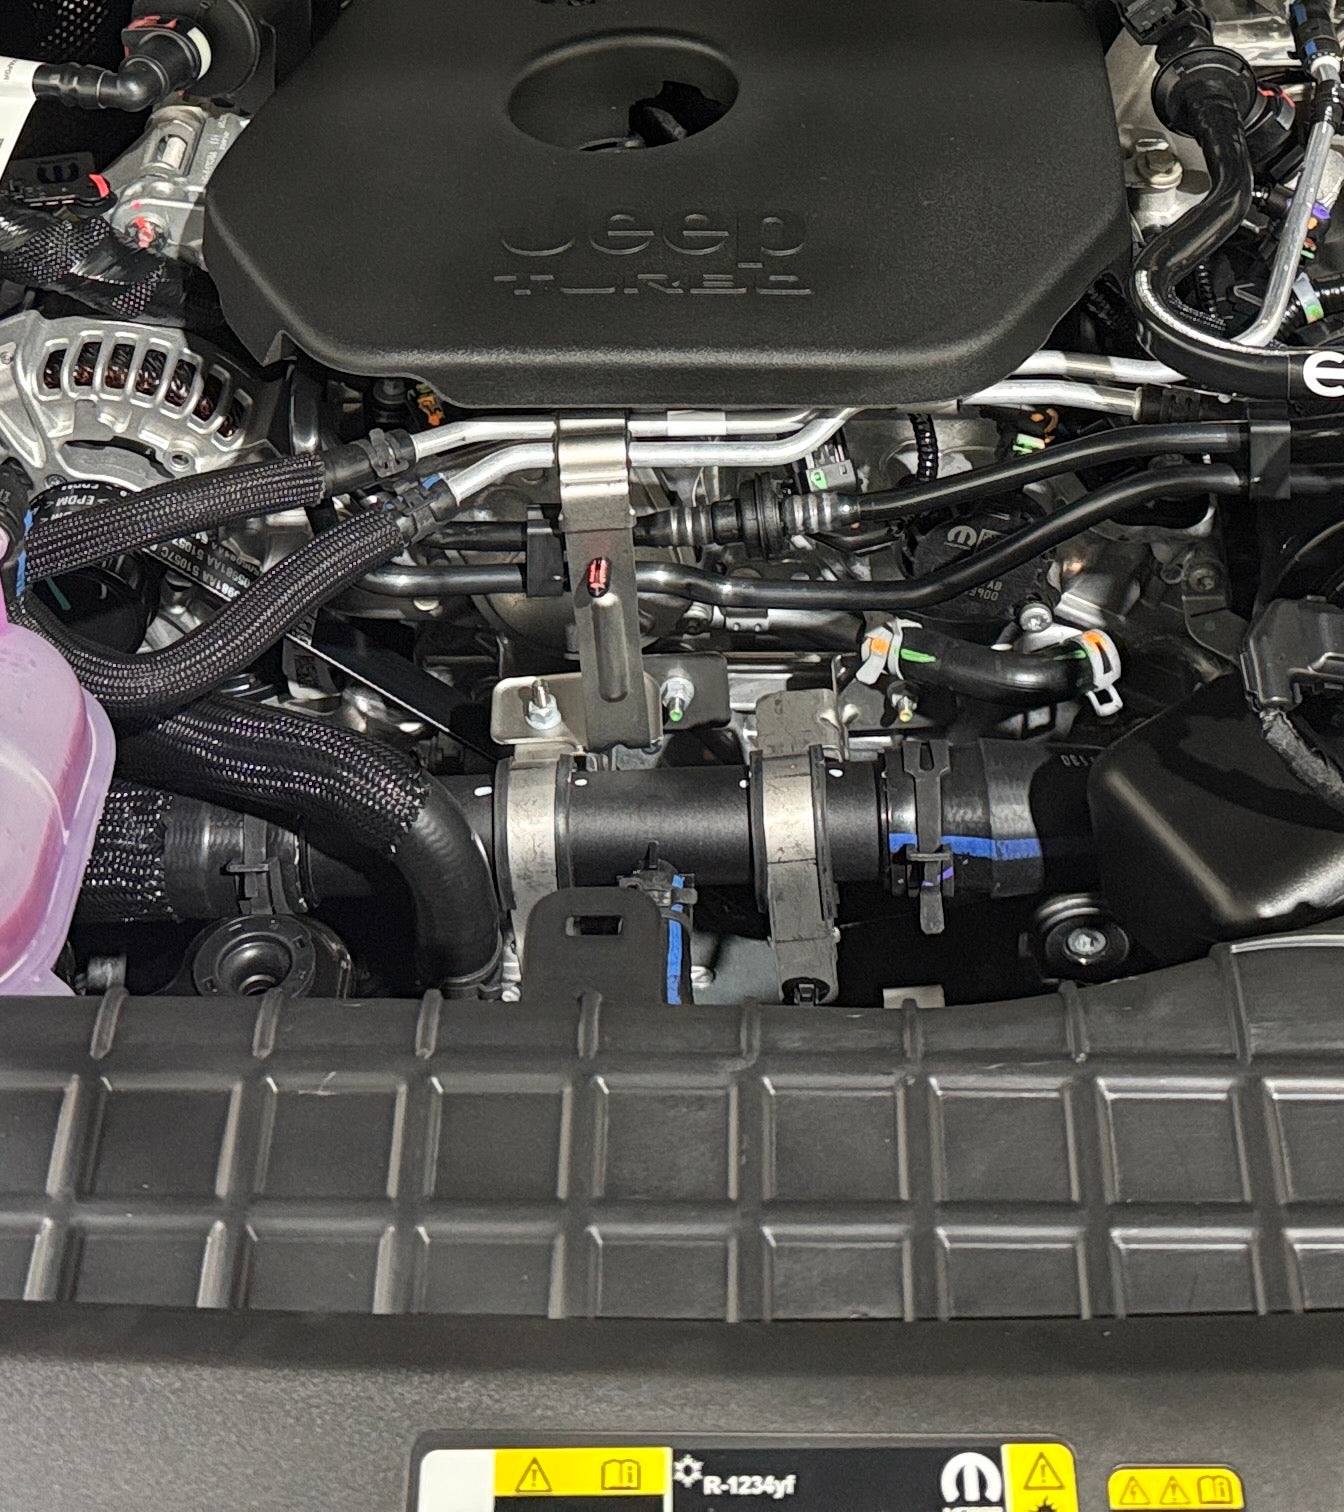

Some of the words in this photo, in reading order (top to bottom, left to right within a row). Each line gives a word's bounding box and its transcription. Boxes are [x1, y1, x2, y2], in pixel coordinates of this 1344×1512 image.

[498, 204, 809, 269] Jeep
[492, 272, 816, 296] TURBO
[703, 1474, 797, 1500] R-1234yf
